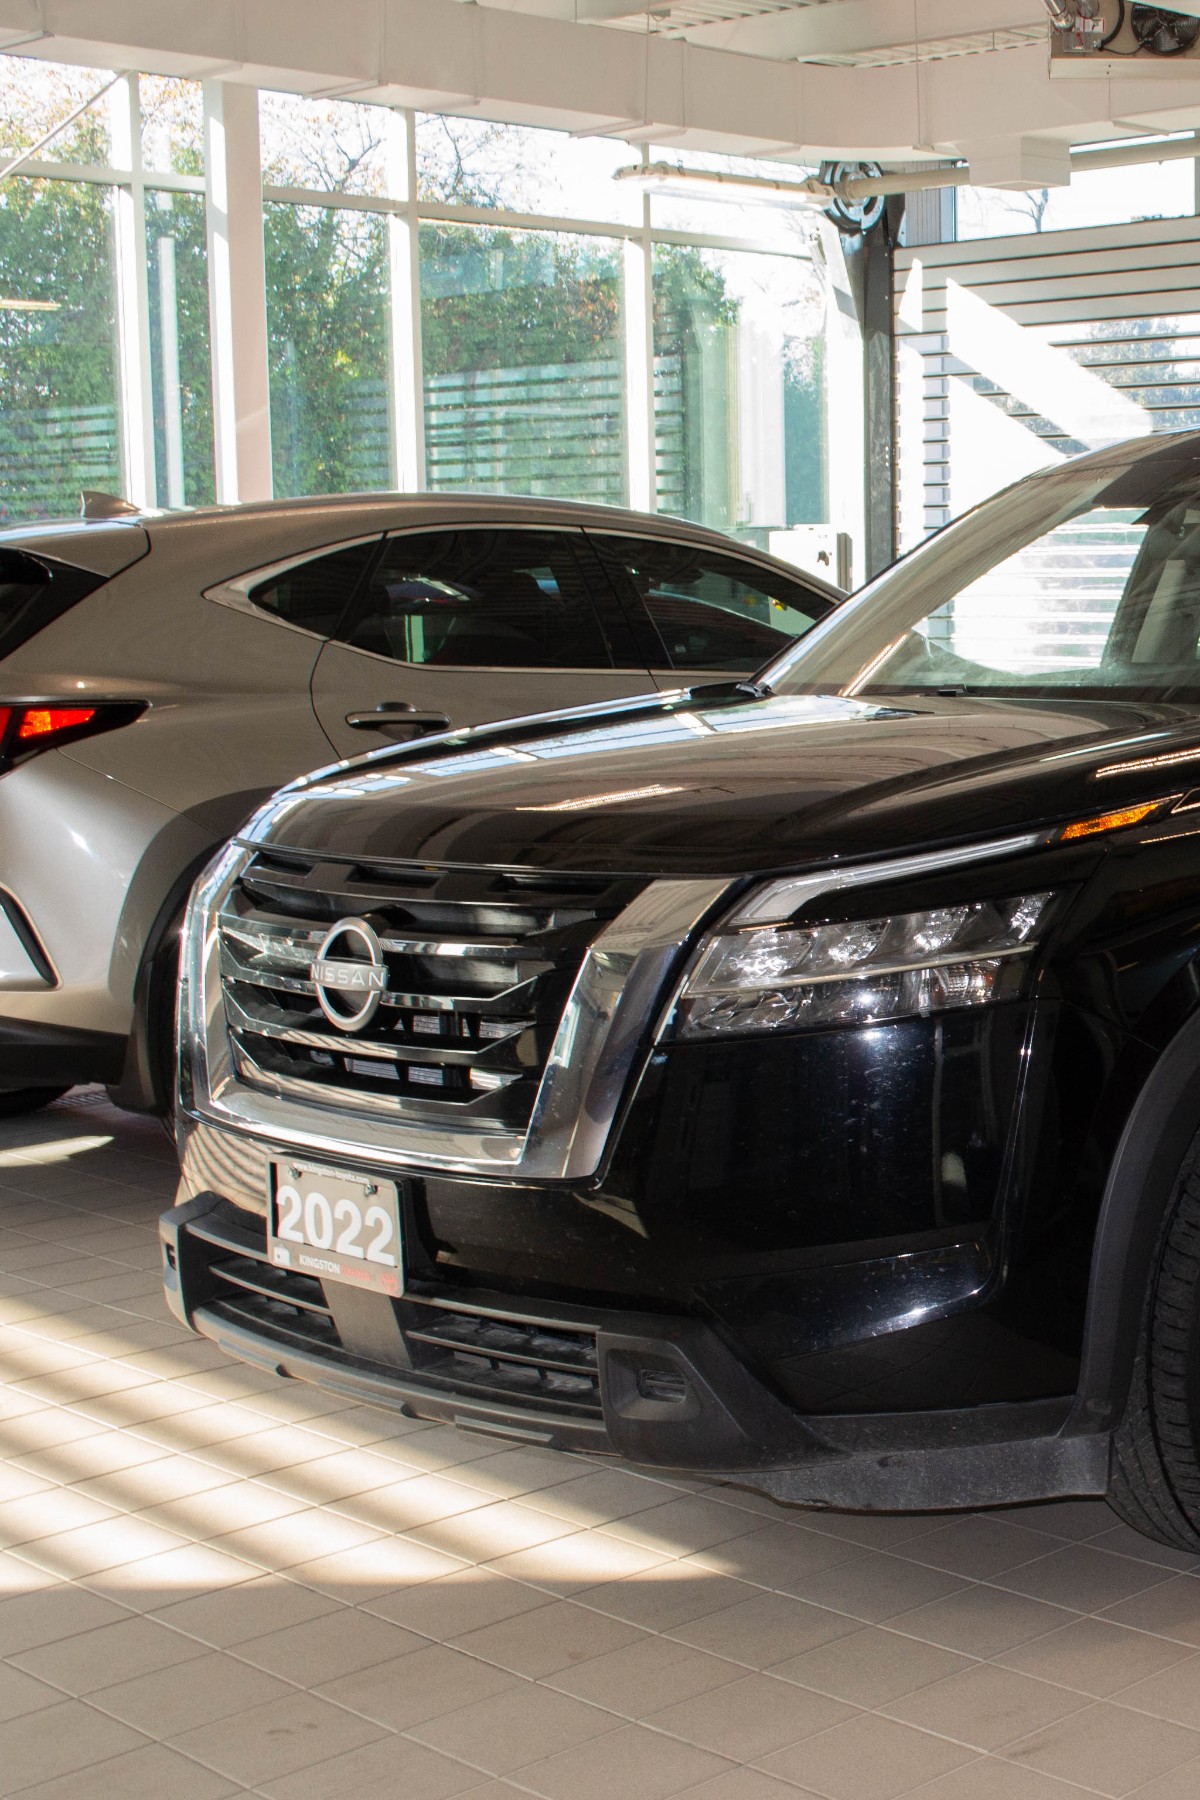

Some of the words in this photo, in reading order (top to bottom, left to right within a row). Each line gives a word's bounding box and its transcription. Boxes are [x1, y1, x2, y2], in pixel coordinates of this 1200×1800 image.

[311, 962, 385, 987] NISSAN
[276, 1185, 395, 1267] 2022
[299, 1254, 341, 1275] KINGSTON
